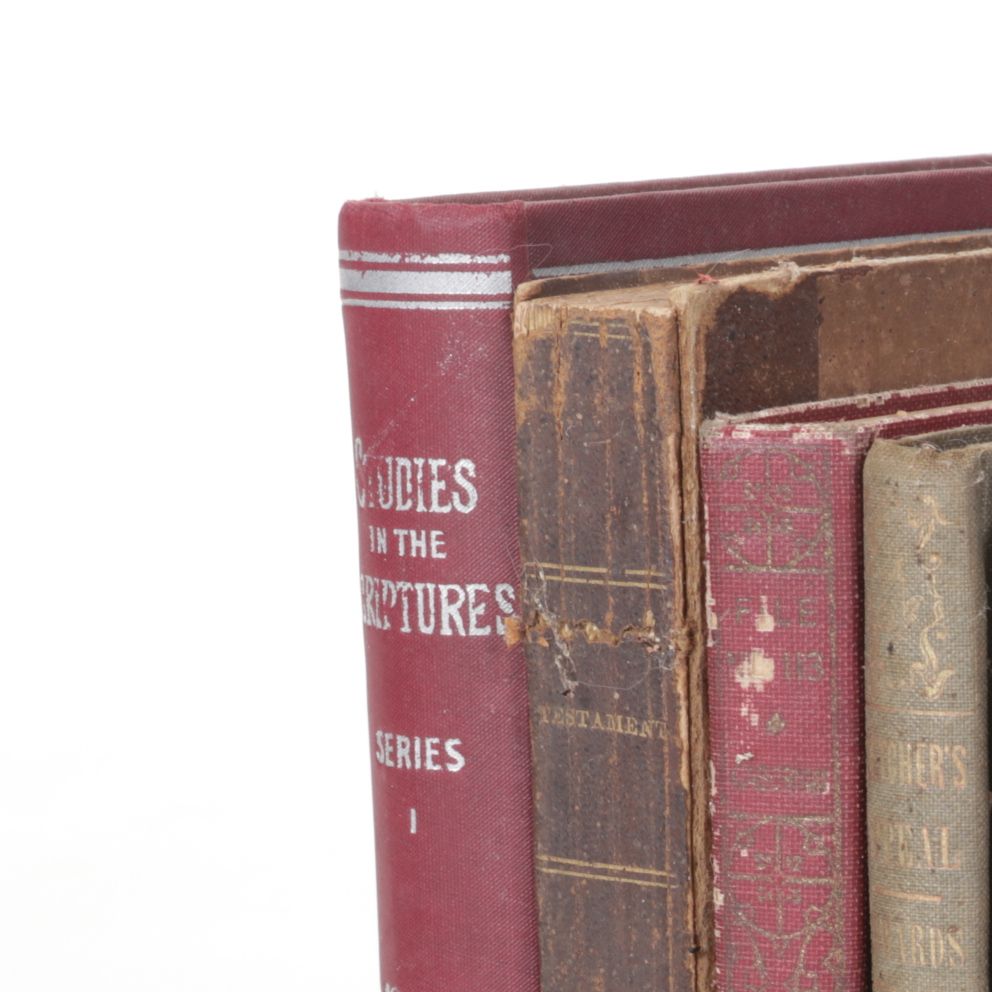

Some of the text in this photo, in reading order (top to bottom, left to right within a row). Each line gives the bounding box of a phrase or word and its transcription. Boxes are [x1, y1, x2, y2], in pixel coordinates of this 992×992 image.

[369, 526, 446, 559] IN THE
[538, 704, 669, 739] TESTAMENT
[376, 730, 466, 772] SERIES
